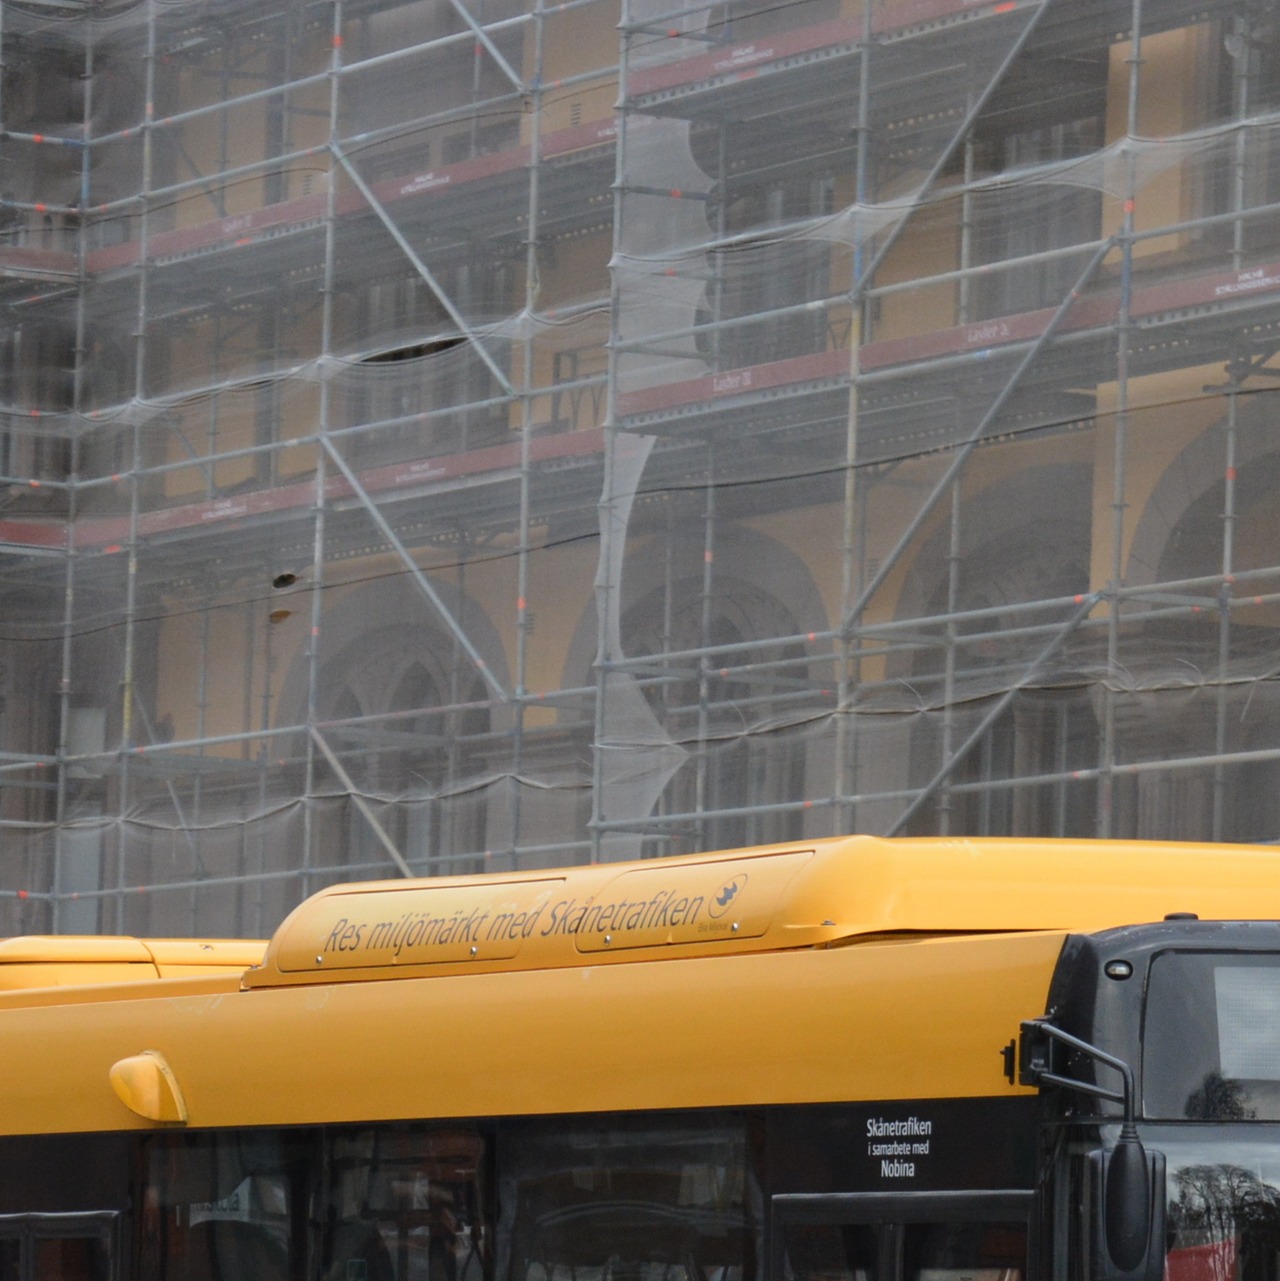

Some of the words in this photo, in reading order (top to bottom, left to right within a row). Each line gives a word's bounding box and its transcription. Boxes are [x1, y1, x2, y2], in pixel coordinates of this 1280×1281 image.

[323, 918, 365, 953] Res
[366, 904, 487, 956] miljömärkt
[486, 901, 546, 939] med
[540, 891, 704, 936] Skånetrafiken
[866, 1116, 933, 1137] Skånetrafiken
[867, 1141, 872, 1156] i
[872, 1140, 911, 1156] samarbete
[912, 1139, 930, 1155] med
[881, 1158, 915, 1178] Nobina
